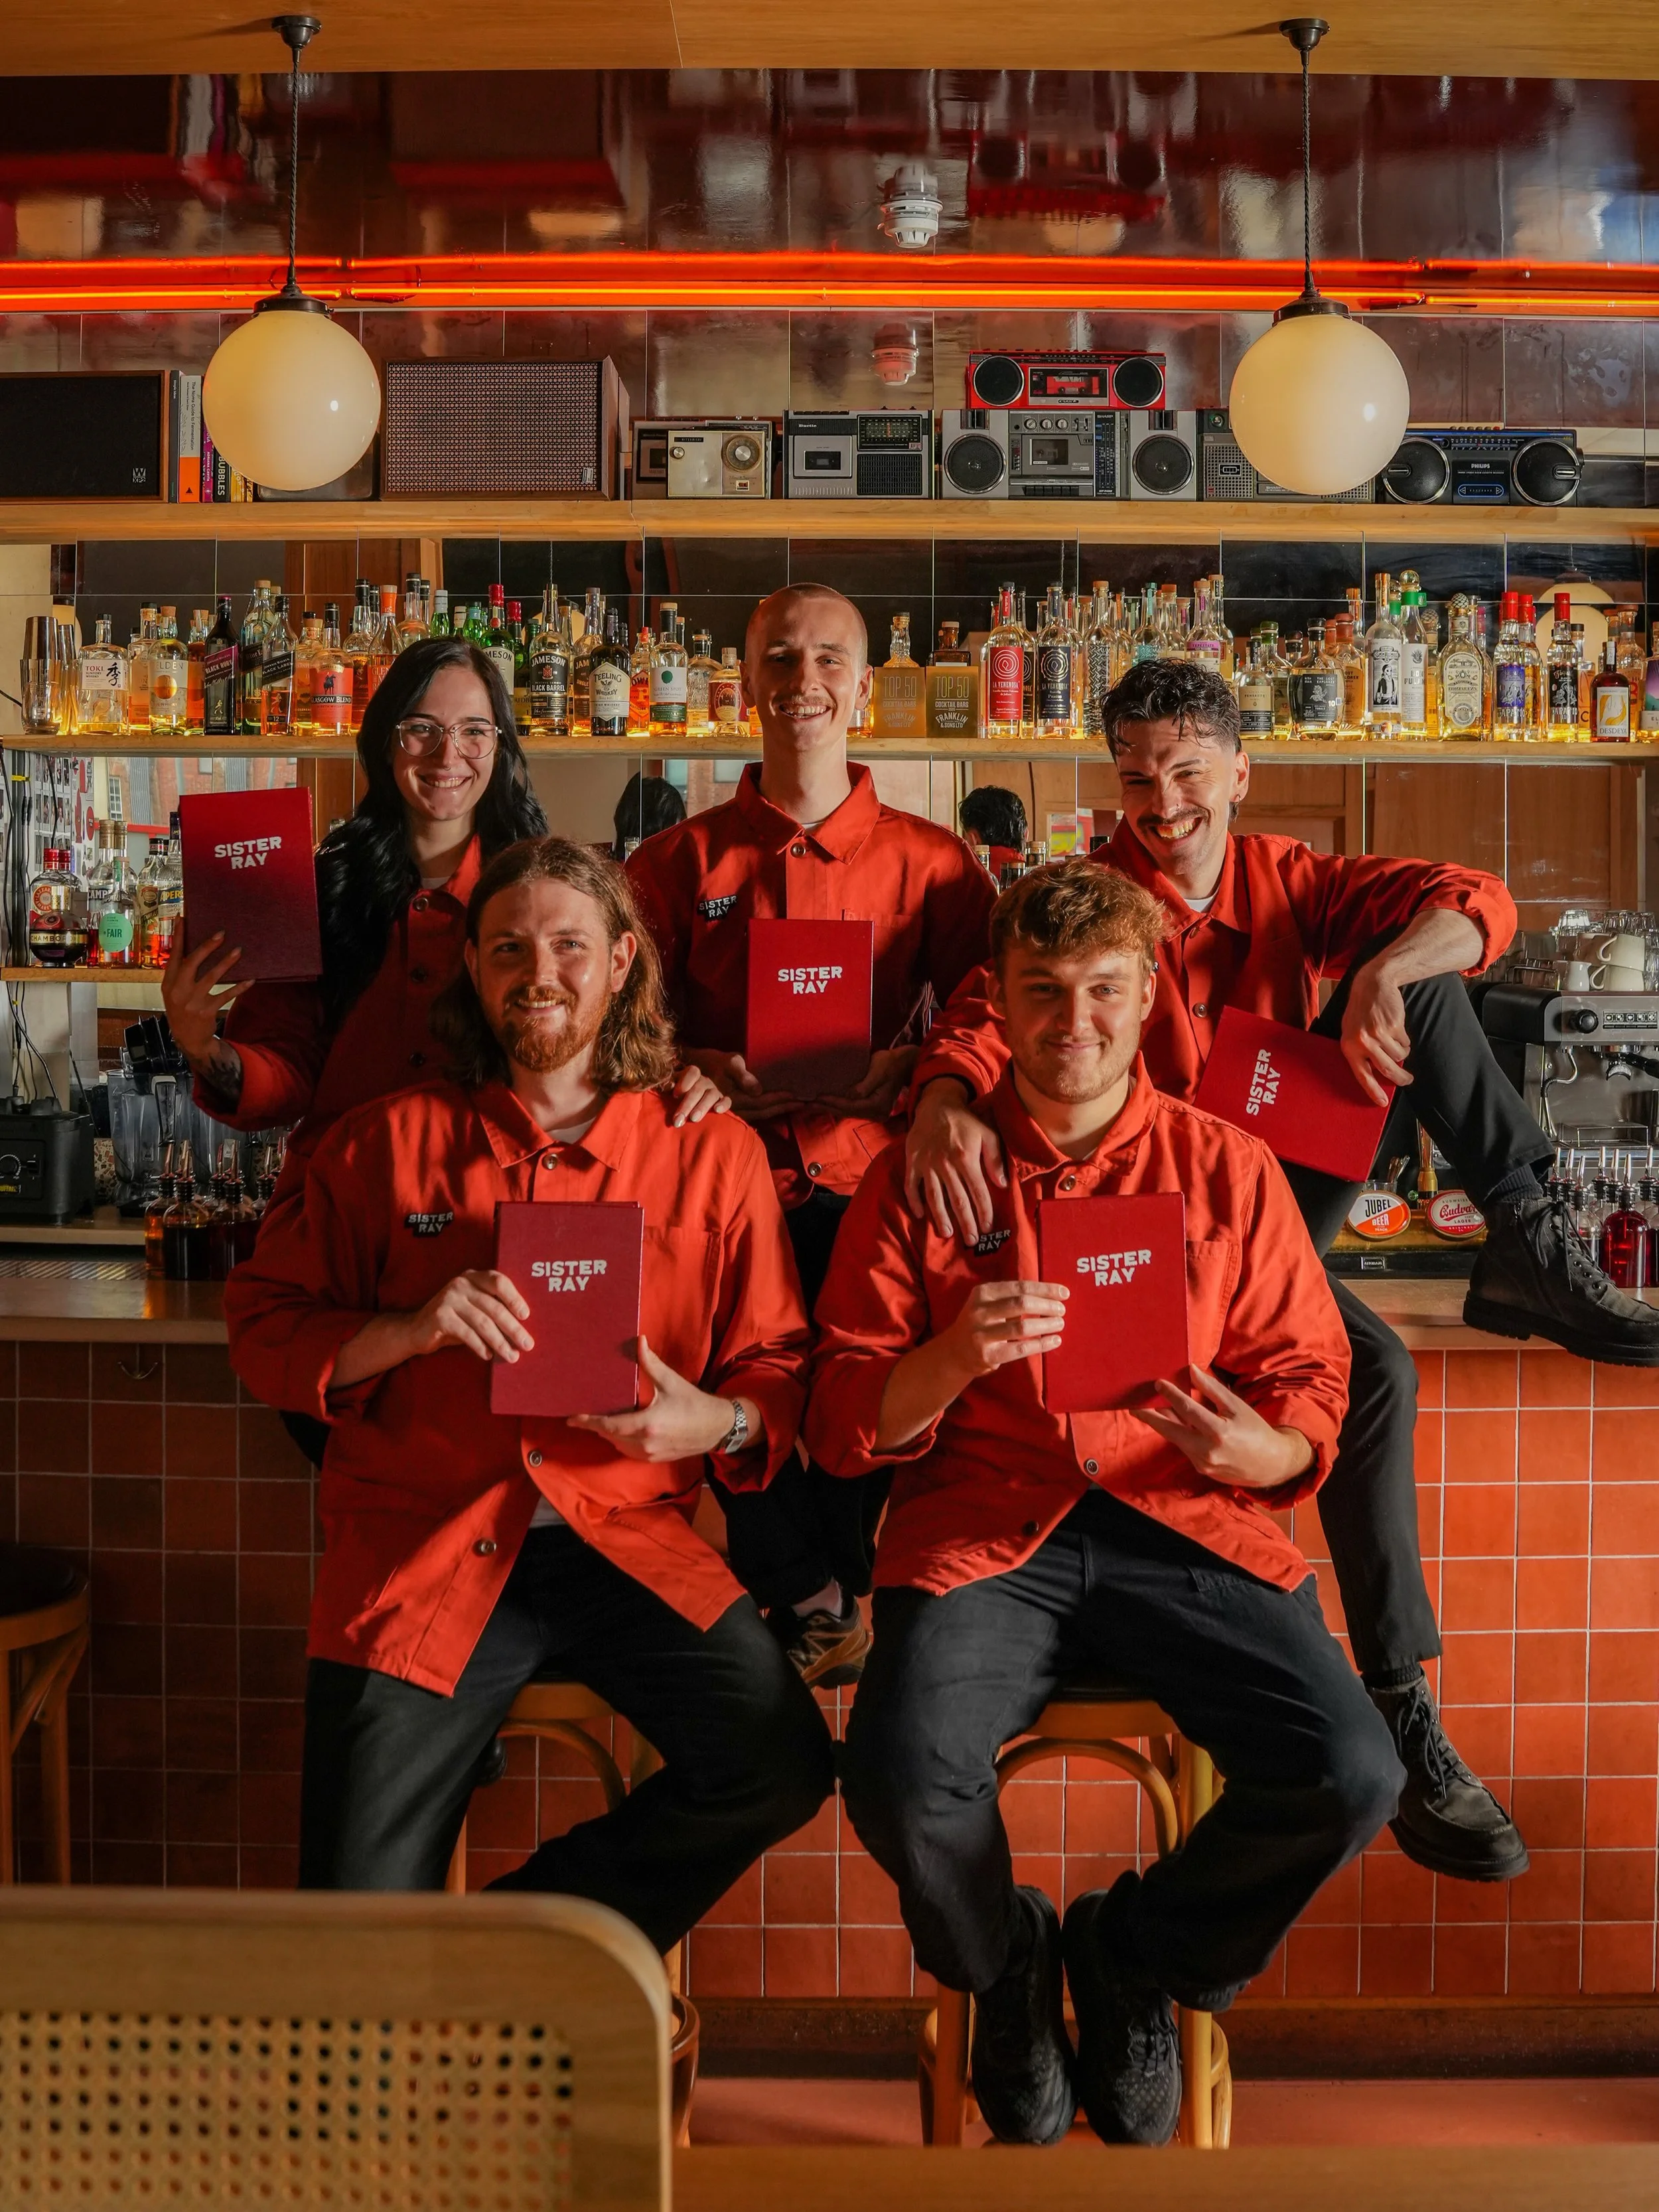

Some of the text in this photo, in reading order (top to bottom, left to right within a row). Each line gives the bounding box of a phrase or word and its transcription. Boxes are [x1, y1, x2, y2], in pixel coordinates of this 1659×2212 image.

[485, 650, 512, 662] MESON
[532, 655, 566, 667] JAMESON
[205, 664, 220, 674] BLACK
[220, 659, 232, 669] RUBY
[594, 672, 622, 682] TEELING
[883, 676, 916, 698] TOP 50
[935, 676, 970, 698] TOP 50
[884, 711, 916, 723] FRANKLIN
[935, 712, 968, 723] FRANKLIN
[214, 836, 281, 858] SISTER
[231, 852, 267, 869] RAY
[699, 896, 737, 911] SISTER
[708, 906, 729, 918] RAY
[107, 928, 122, 938] FAIR
[778, 966, 843, 982] SISTER
[793, 980, 828, 994] RAY
[1246, 1049, 1271, 1116] SISTER
[1262, 1067, 1281, 1104] RAY
[1365, 1199, 1392, 1218] JUBEL
[1439, 1203, 1477, 1220] Budvar
[408, 1211, 454, 1223] SISTER
[1372, 1214, 1389, 1226] BEER
[419, 1223, 444, 1233] RAY
[979, 1229, 1011, 1242] STER
[978, 1239, 1002, 1252] RAY
[1076, 1248, 1152, 1273] SISTER
[531, 1260, 607, 1277] SISTER
[548, 1276, 590, 1292] RAY
[1095, 1268, 1135, 1286] RAY
